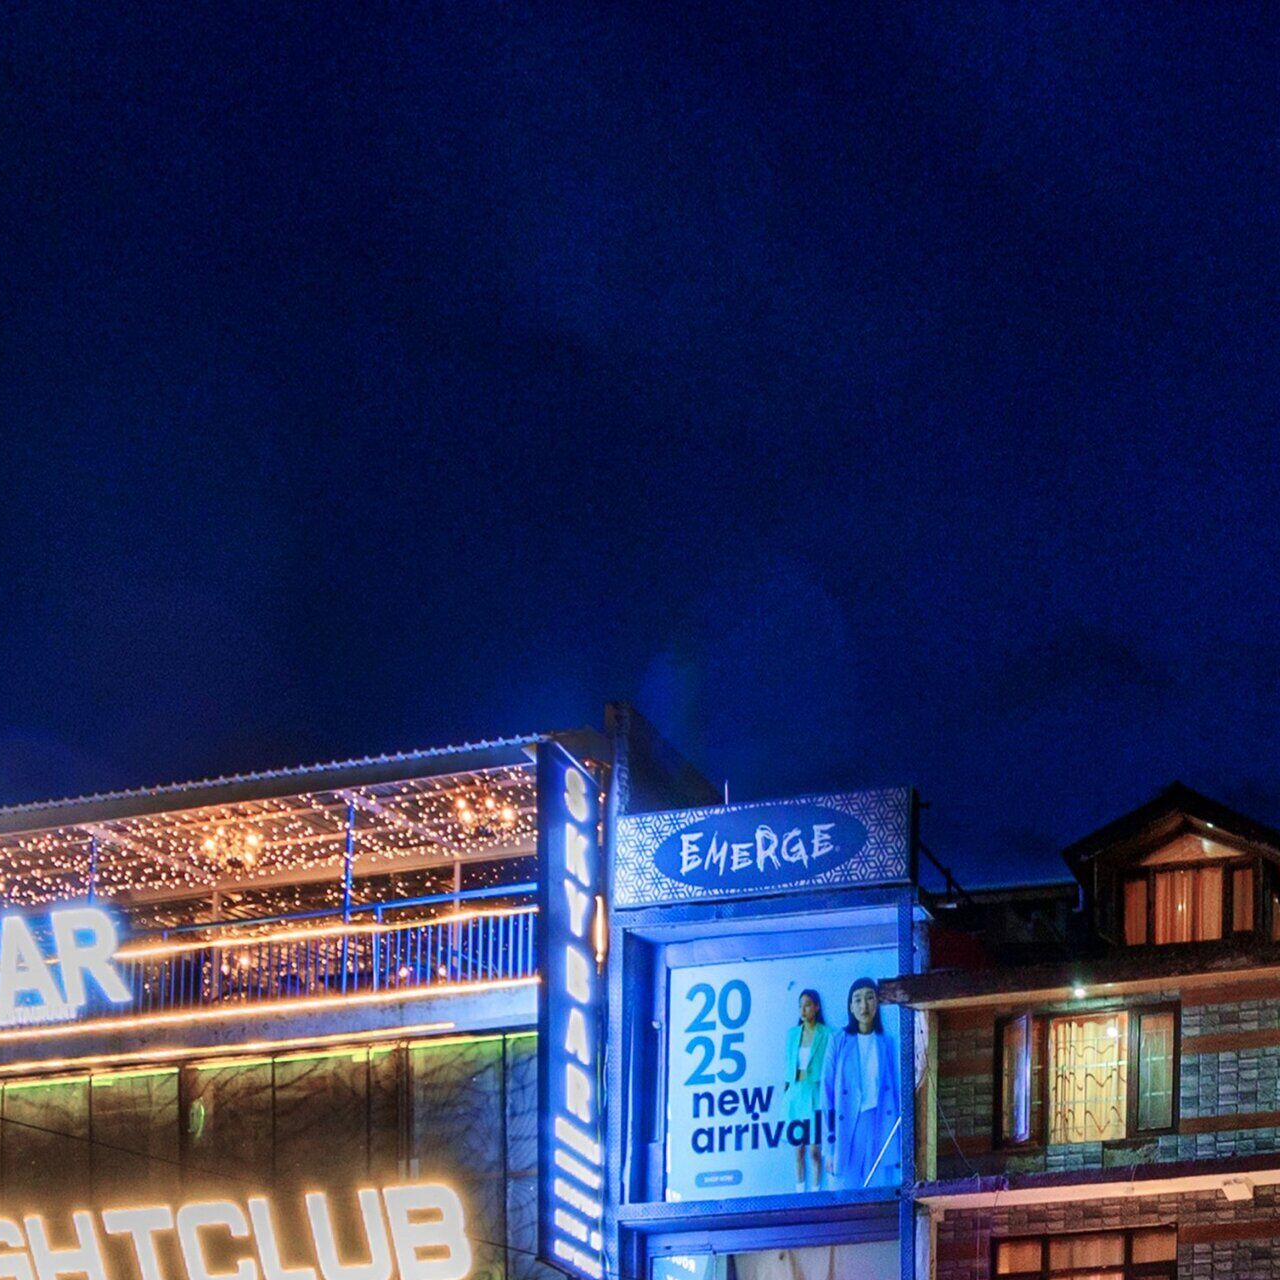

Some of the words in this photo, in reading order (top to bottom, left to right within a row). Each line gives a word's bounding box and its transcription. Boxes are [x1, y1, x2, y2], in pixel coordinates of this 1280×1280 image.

[680, 823, 836, 876] EMERGE
[684, 979, 752, 1033] 20
[684, 1032, 747, 1087] 25
[692, 1086, 774, 1119] new
